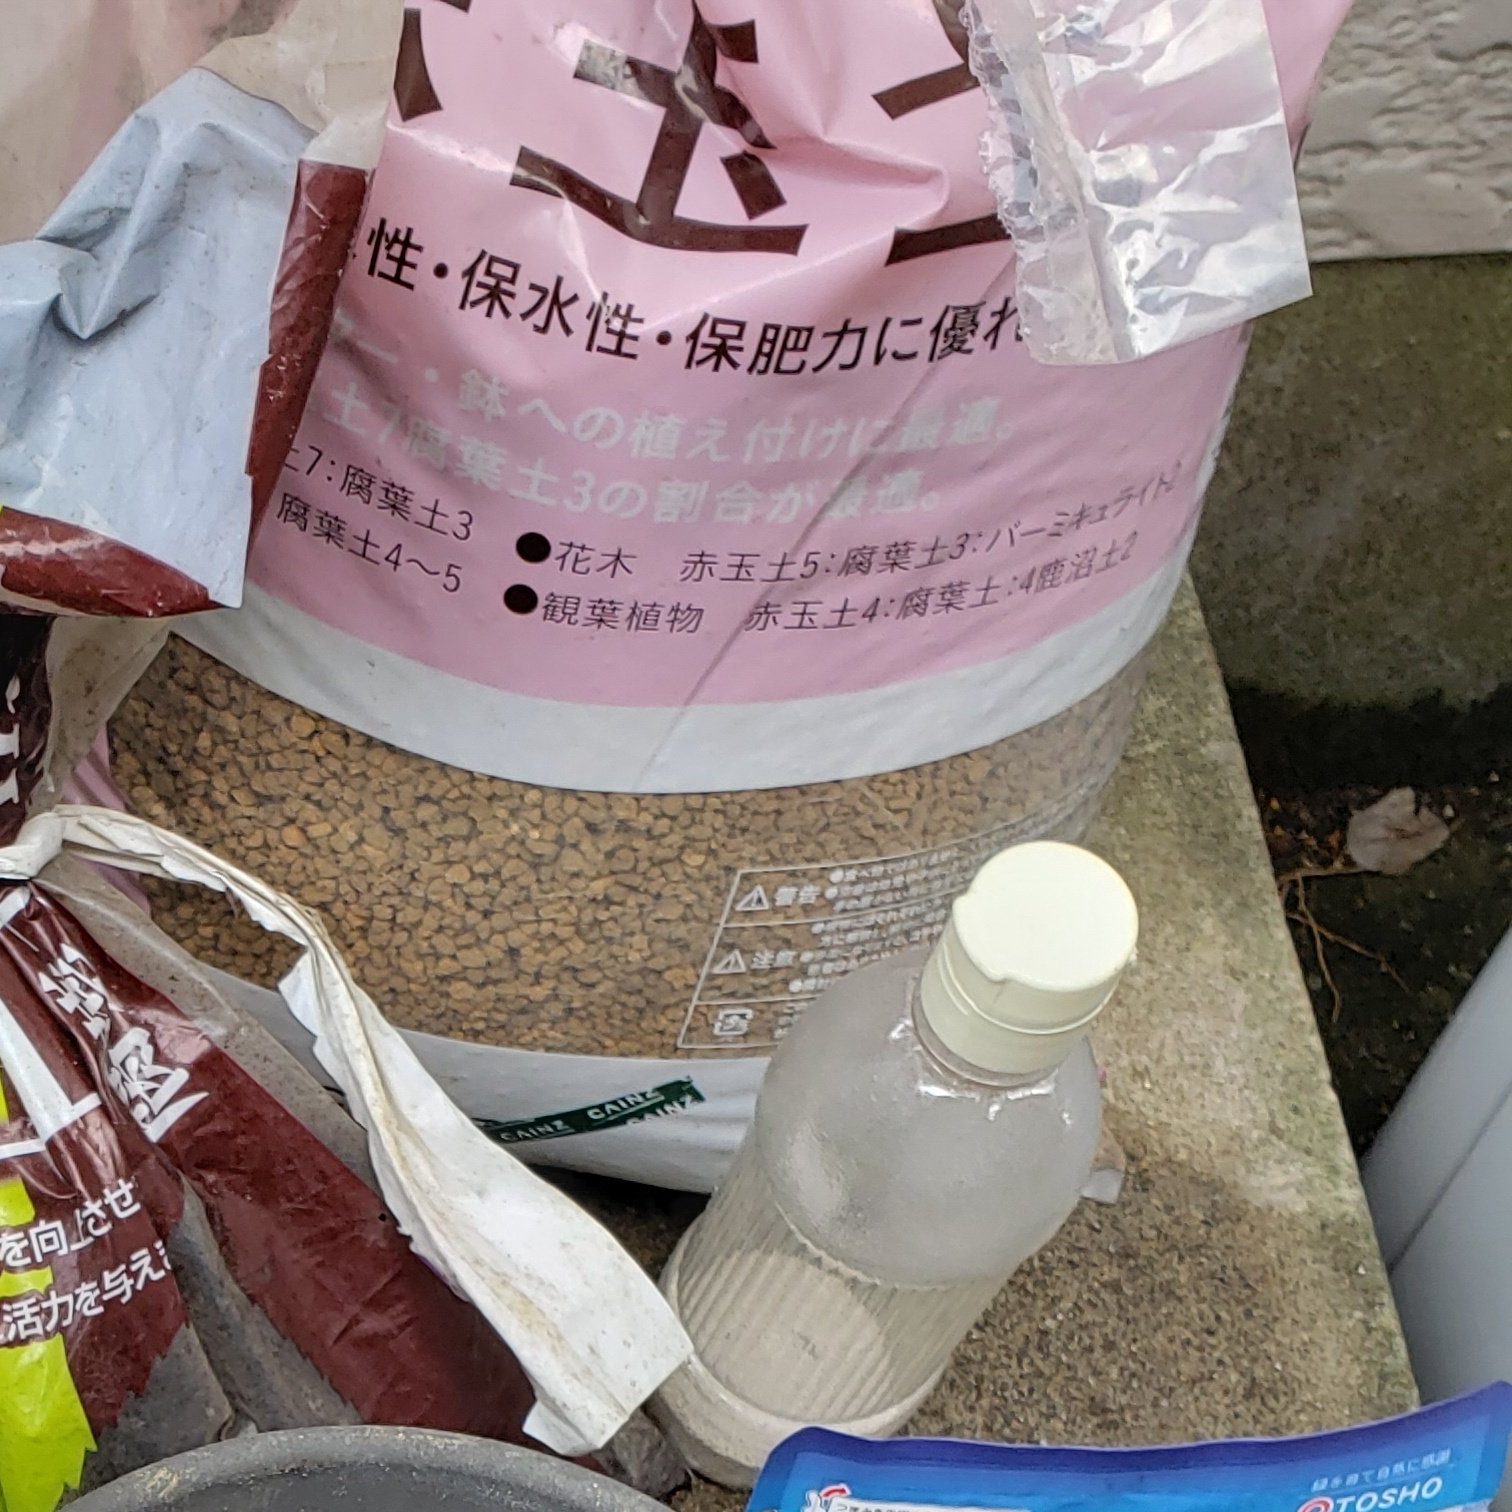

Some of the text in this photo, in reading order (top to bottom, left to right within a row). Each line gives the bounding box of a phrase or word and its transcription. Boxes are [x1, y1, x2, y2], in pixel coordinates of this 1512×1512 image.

[554, 539, 638, 580] 花木
[541, 590, 705, 635] 観葉植物
[587, 1087, 664, 1120] CAINZ
[500, 1118, 572, 1142] CAINZ
